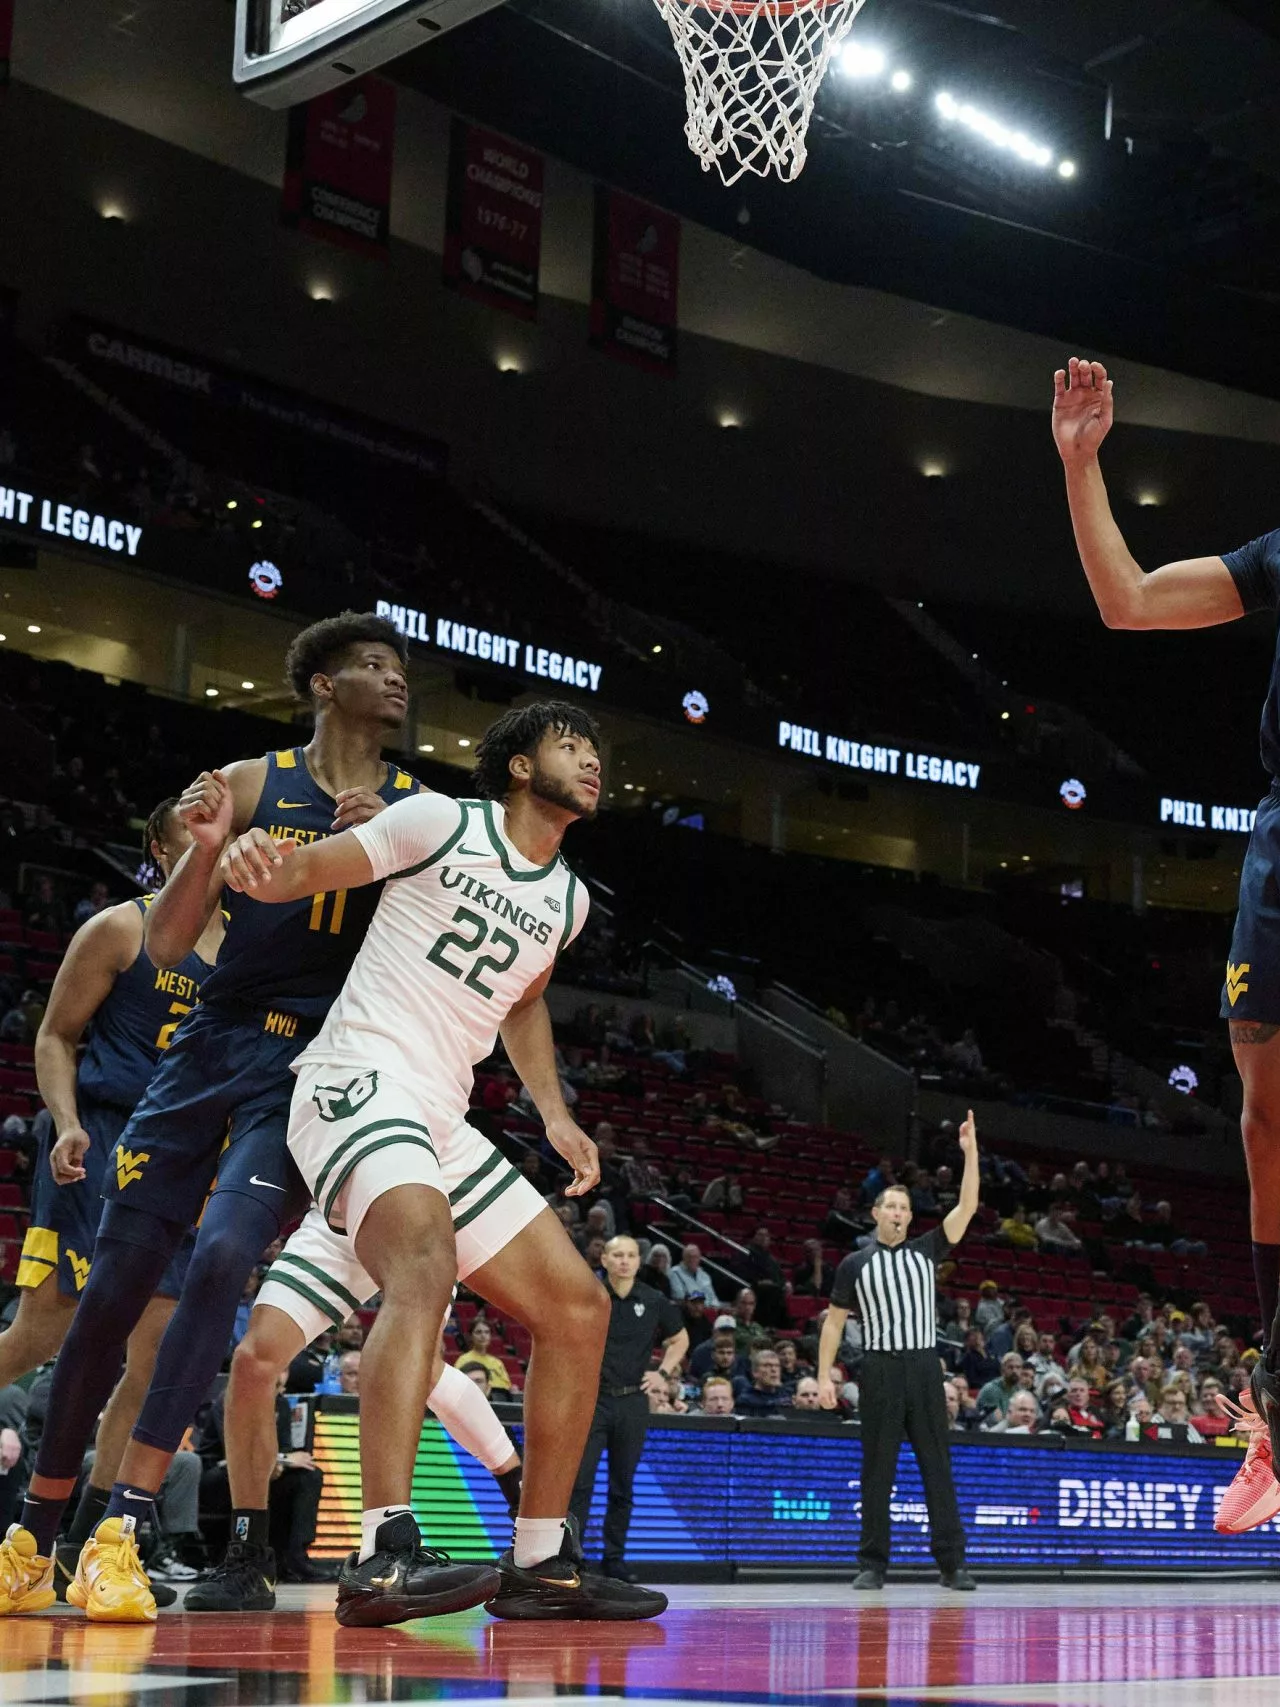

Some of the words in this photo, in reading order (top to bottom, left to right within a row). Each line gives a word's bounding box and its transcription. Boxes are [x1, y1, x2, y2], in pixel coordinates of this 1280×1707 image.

[482, 147, 530, 180] WORLD
[41, 499, 143, 556] LEGACY
[436, 618, 520, 668] KNIGHT
[525, 645, 602, 692] LEGACY
[779, 721, 822, 757] PHIL
[826, 735, 901, 775] KNIGHT
[905, 752, 981, 789] LEGACY
[1160, 798, 1206, 828] PHIL
[1211, 805, 1258, 833] KNI
[439, 866, 552, 946] VIKINGS
[426, 905, 520, 1000] 22
[154, 969, 195, 1000] WEST
[264, 1010, 298, 1038] WVU
[773, 1490, 831, 1520] hulu
[1059, 1479, 1203, 1530] DISNEY
